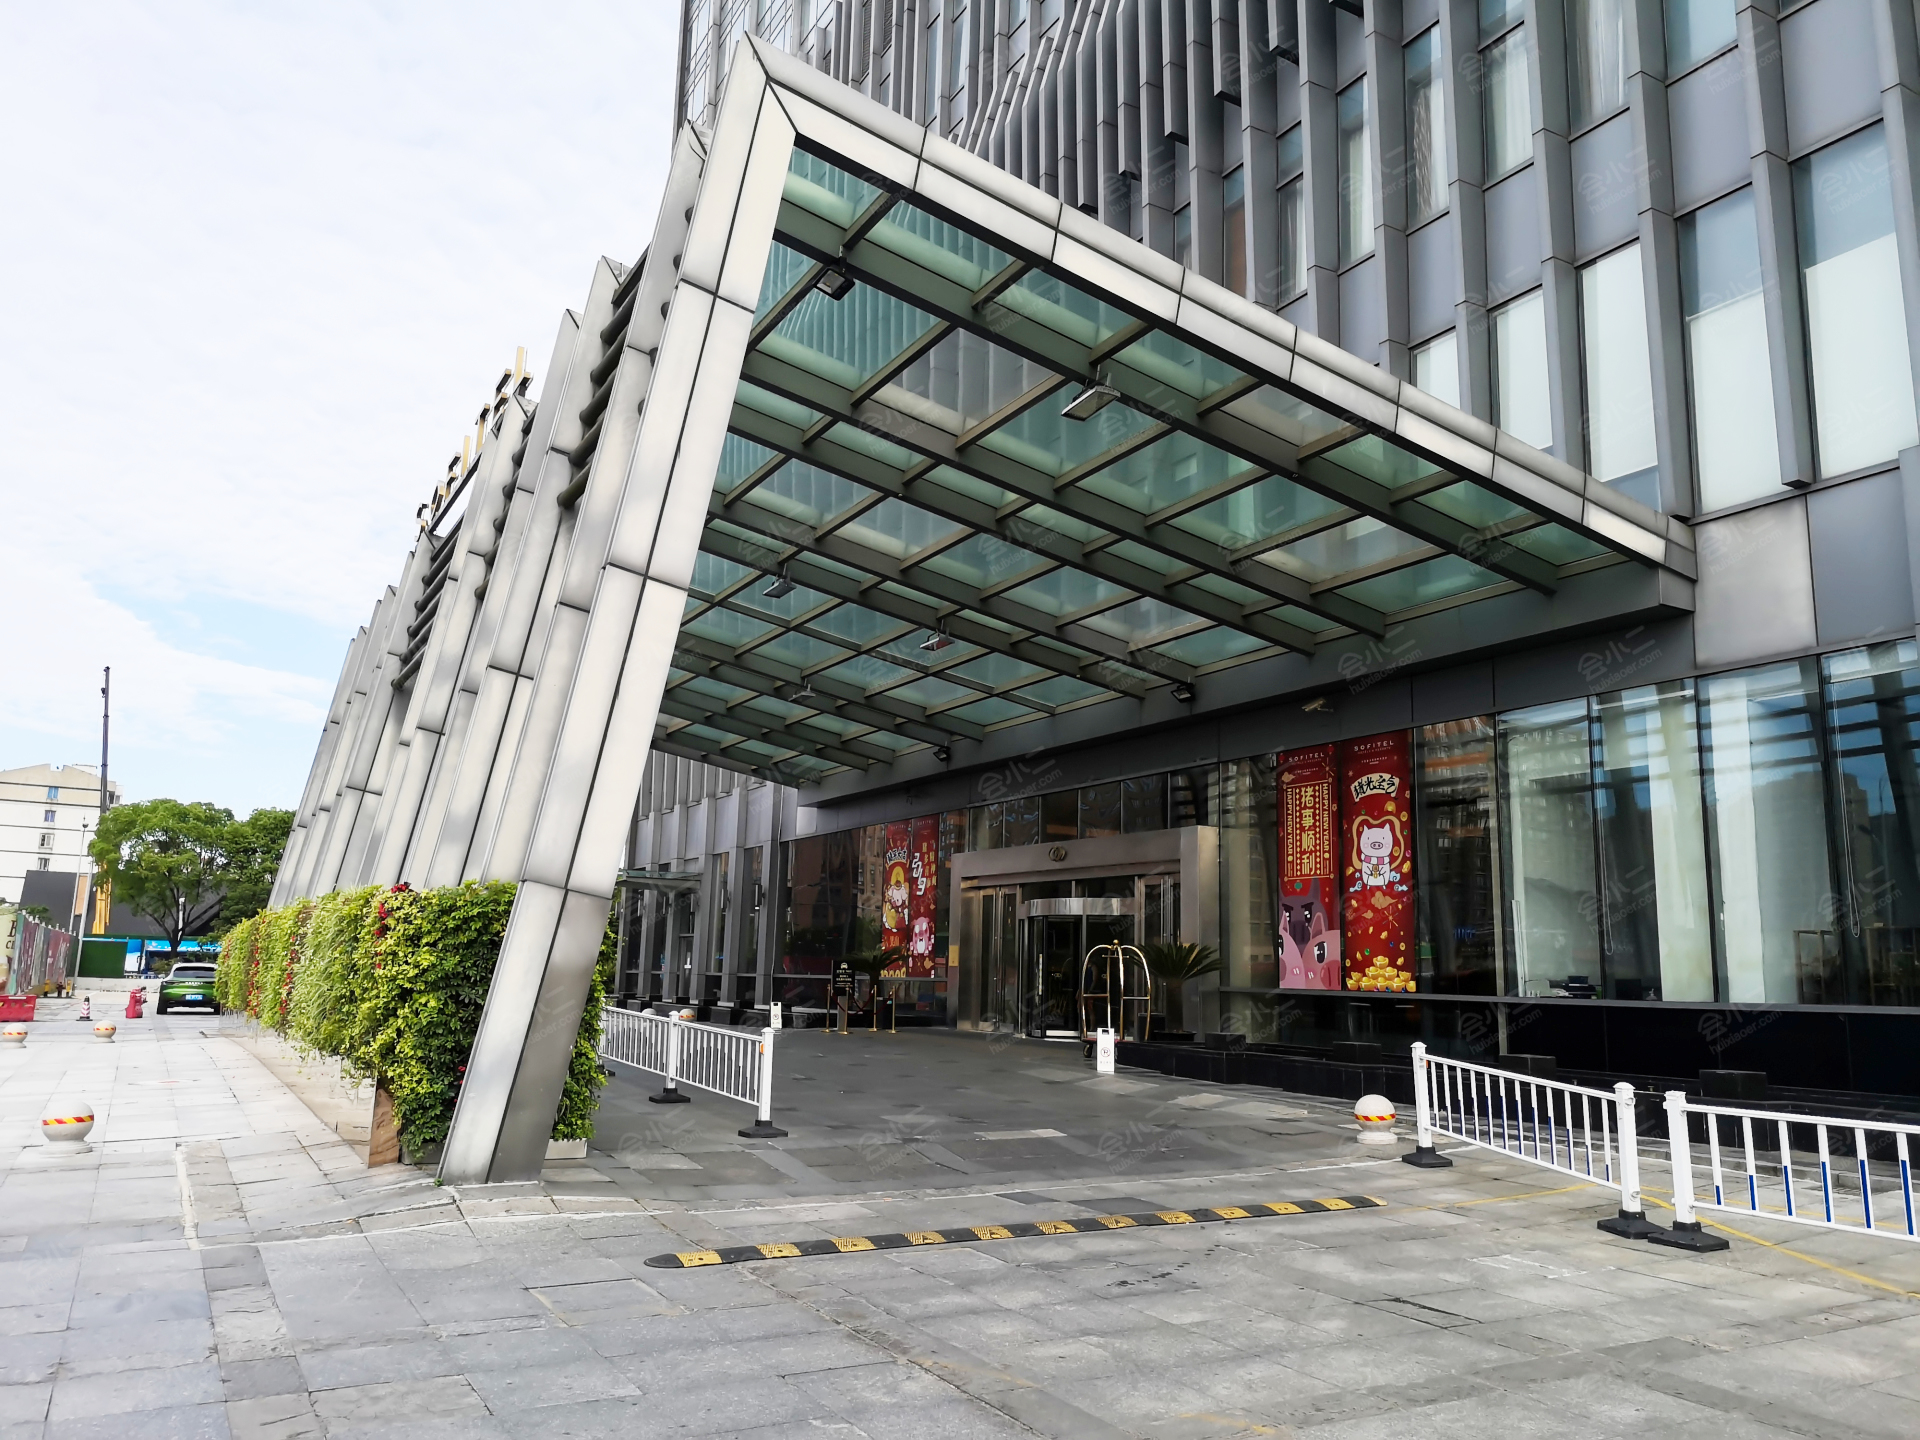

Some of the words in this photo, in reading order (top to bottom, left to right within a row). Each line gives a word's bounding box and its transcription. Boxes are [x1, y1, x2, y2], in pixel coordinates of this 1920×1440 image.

[1288, 752, 1324, 763] SOFITEL
[1354, 740, 1394, 752] SOFITEL
[1300, 785, 1316, 877] 猪事顺利
[911, 852, 927, 896] 2019
